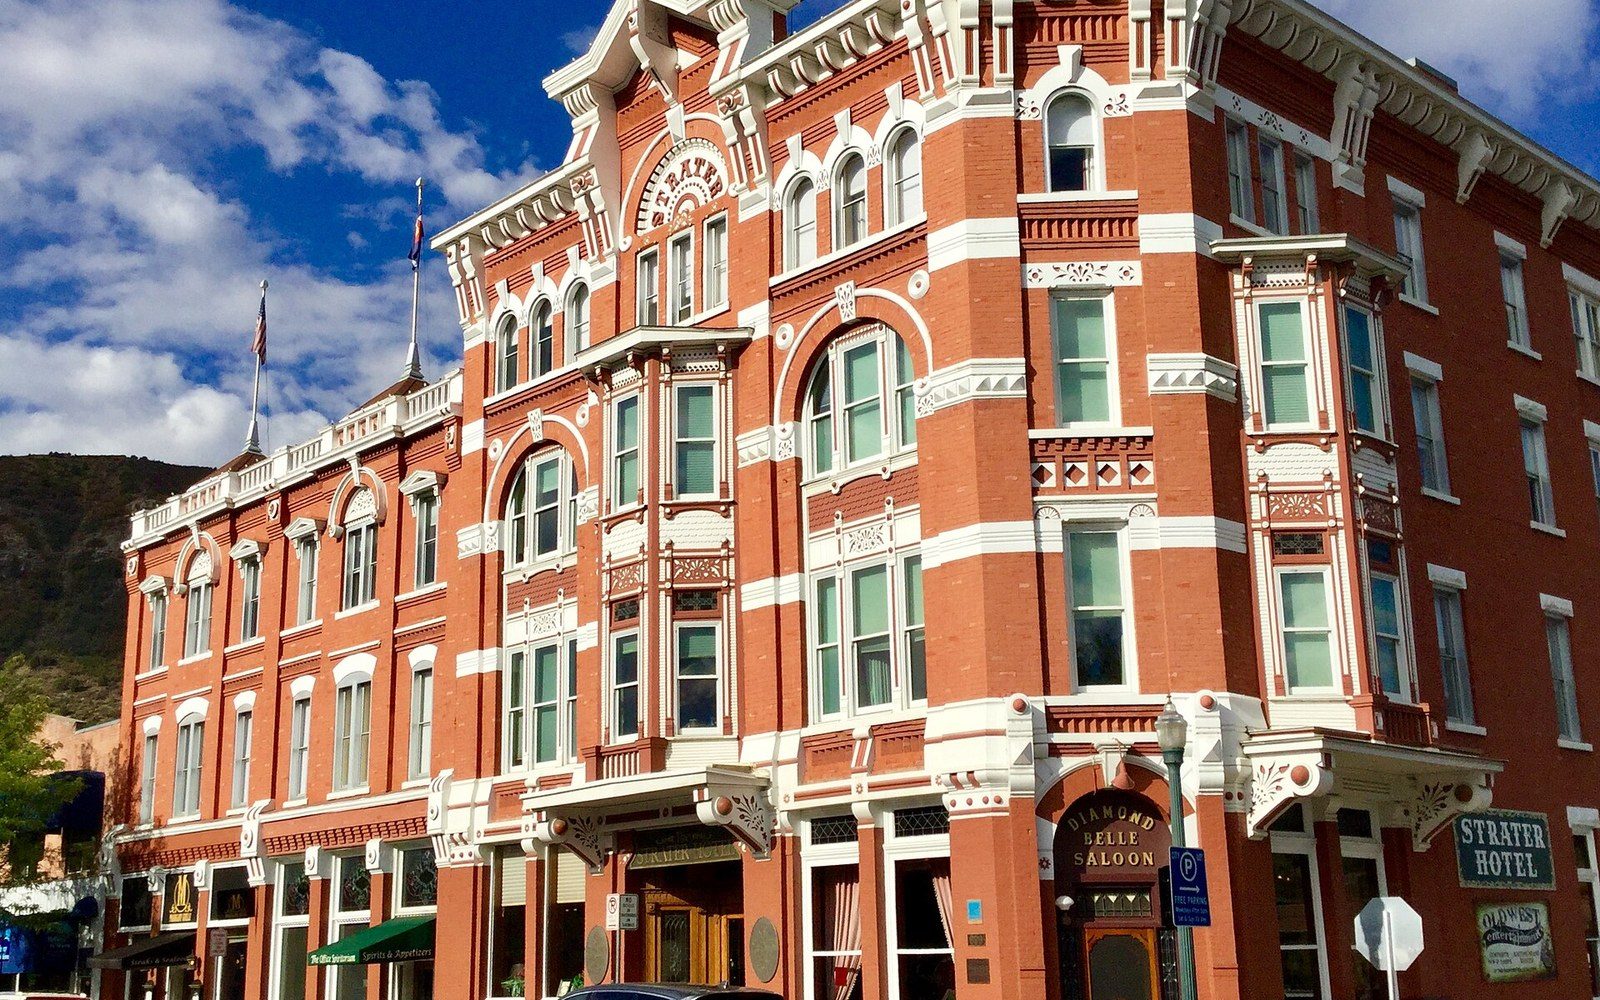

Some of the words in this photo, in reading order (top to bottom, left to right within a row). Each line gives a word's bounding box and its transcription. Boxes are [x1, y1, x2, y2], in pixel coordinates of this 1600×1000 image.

[651, 157, 724, 228] STRATER
[1067, 805, 1155, 831] DIAMOND
[1084, 831, 1139, 846] BELLE
[1460, 817, 1547, 849] STRATER
[1074, 851, 1155, 866] SALOON
[1474, 849, 1538, 878] HOTEL
[1507, 906, 1541, 928] WEST
[310, 954, 319, 964] The
[362, 951, 386, 962] Spirits
[386, 950, 393, 958] &
[394, 948, 432, 959] Appetizers
